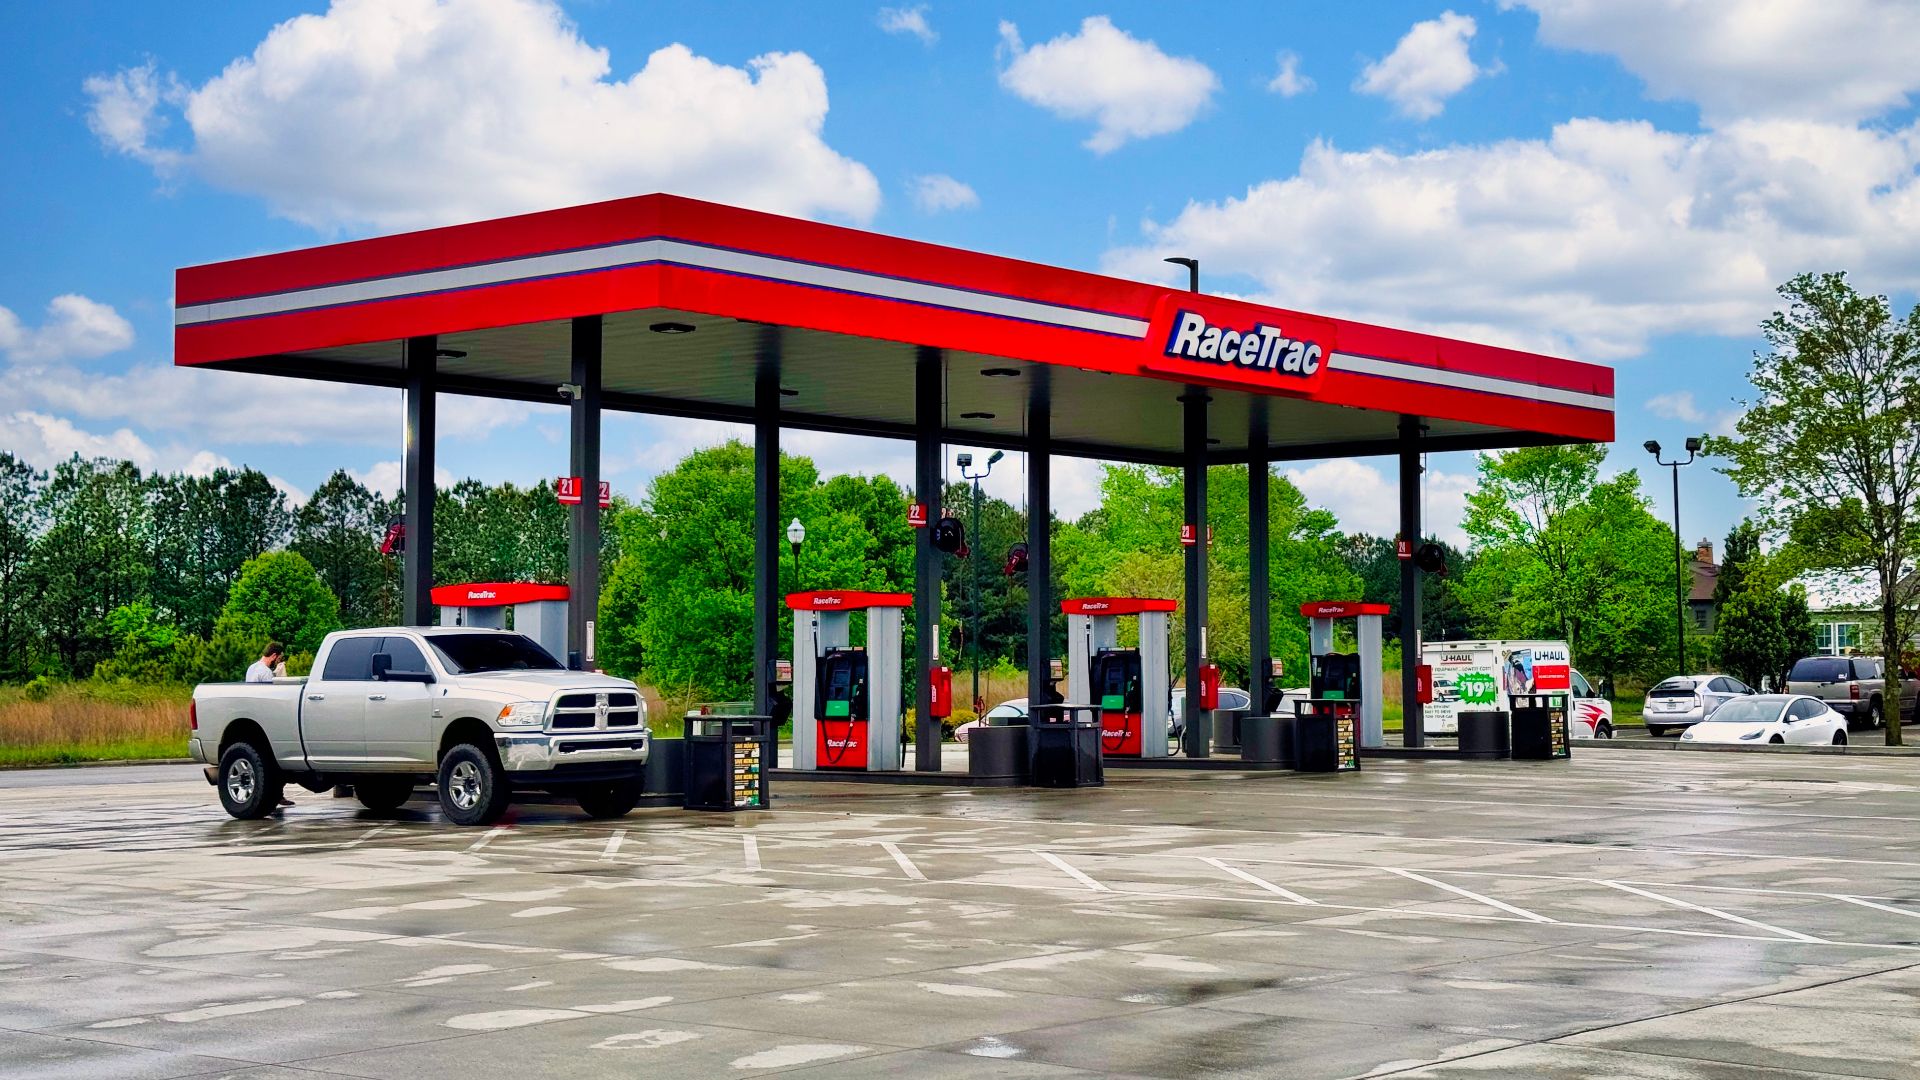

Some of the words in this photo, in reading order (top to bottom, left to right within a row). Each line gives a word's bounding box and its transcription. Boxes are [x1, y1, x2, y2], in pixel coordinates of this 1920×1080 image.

[1165, 310, 1322, 377] RaceTrac
[561, 478, 573, 495] 21
[910, 504, 920, 518] 22
[1181, 525, 1190, 538] 23
[1398, 541, 1406, 552] 24
[468, 591, 496, 599] RaceTrac
[813, 597, 842, 605] RaceTrac
[1535, 651, 1565, 660] U-HAUL
